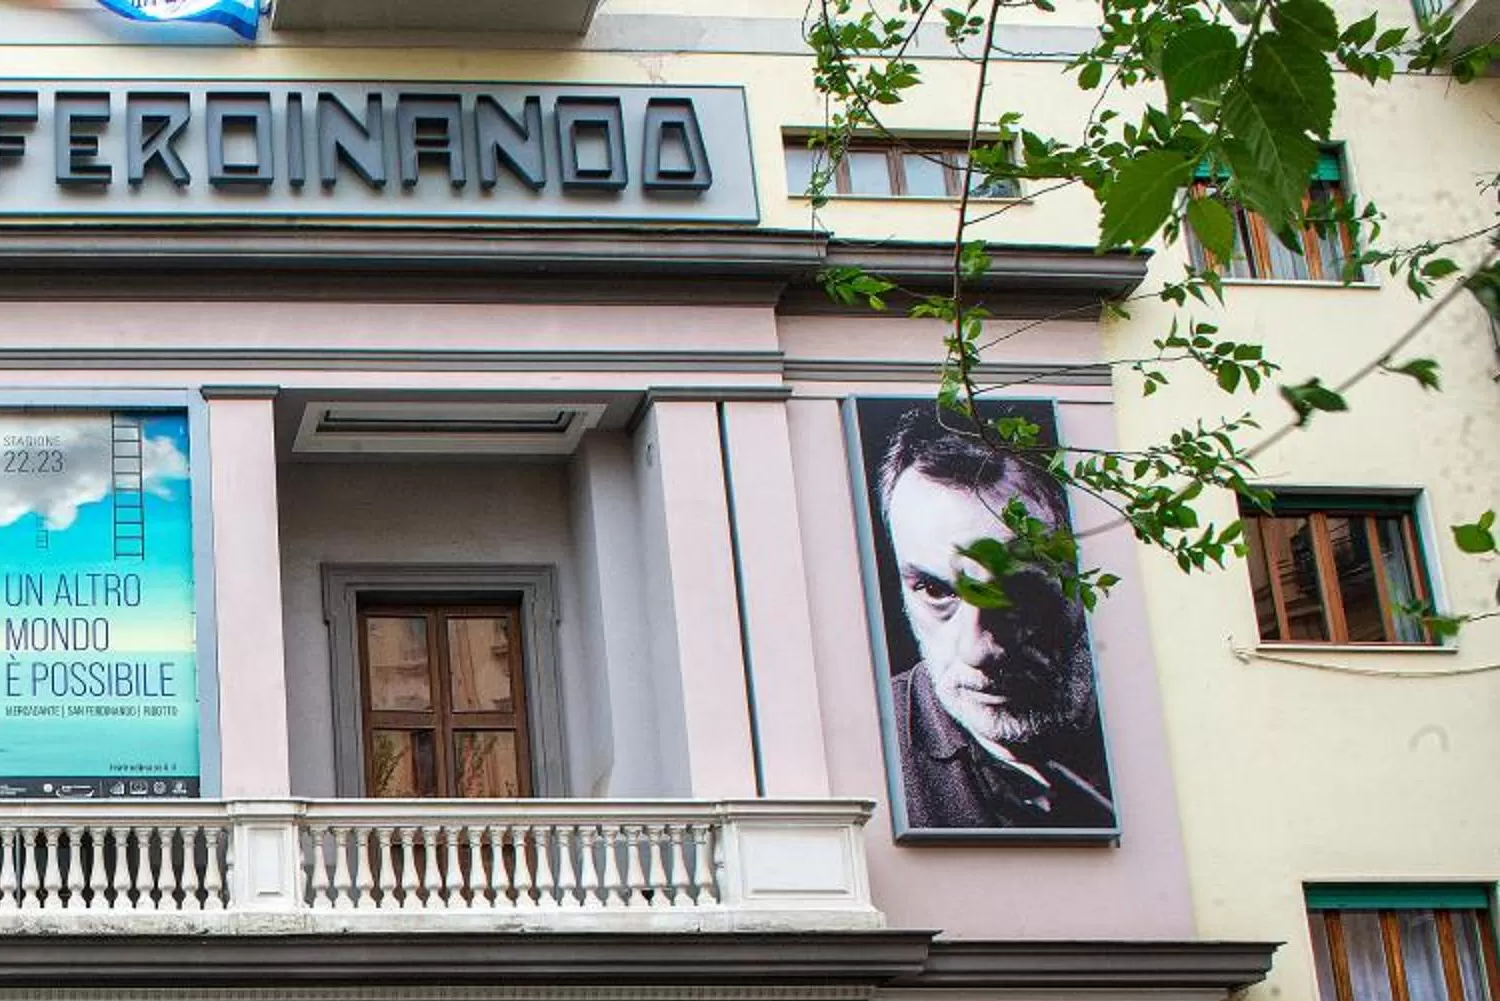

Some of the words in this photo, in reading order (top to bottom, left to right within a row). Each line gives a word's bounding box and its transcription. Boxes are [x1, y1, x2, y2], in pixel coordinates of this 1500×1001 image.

[3, 435, 61, 447] STAGIONE
[3, 450, 64, 473] 22.23
[5, 573, 42, 607] UN
[54, 573, 141, 607] ALTRO
[5, 617, 110, 652] MONDO
[6, 653, 22, 697] È
[32, 662, 176, 697] POSSIBILE
